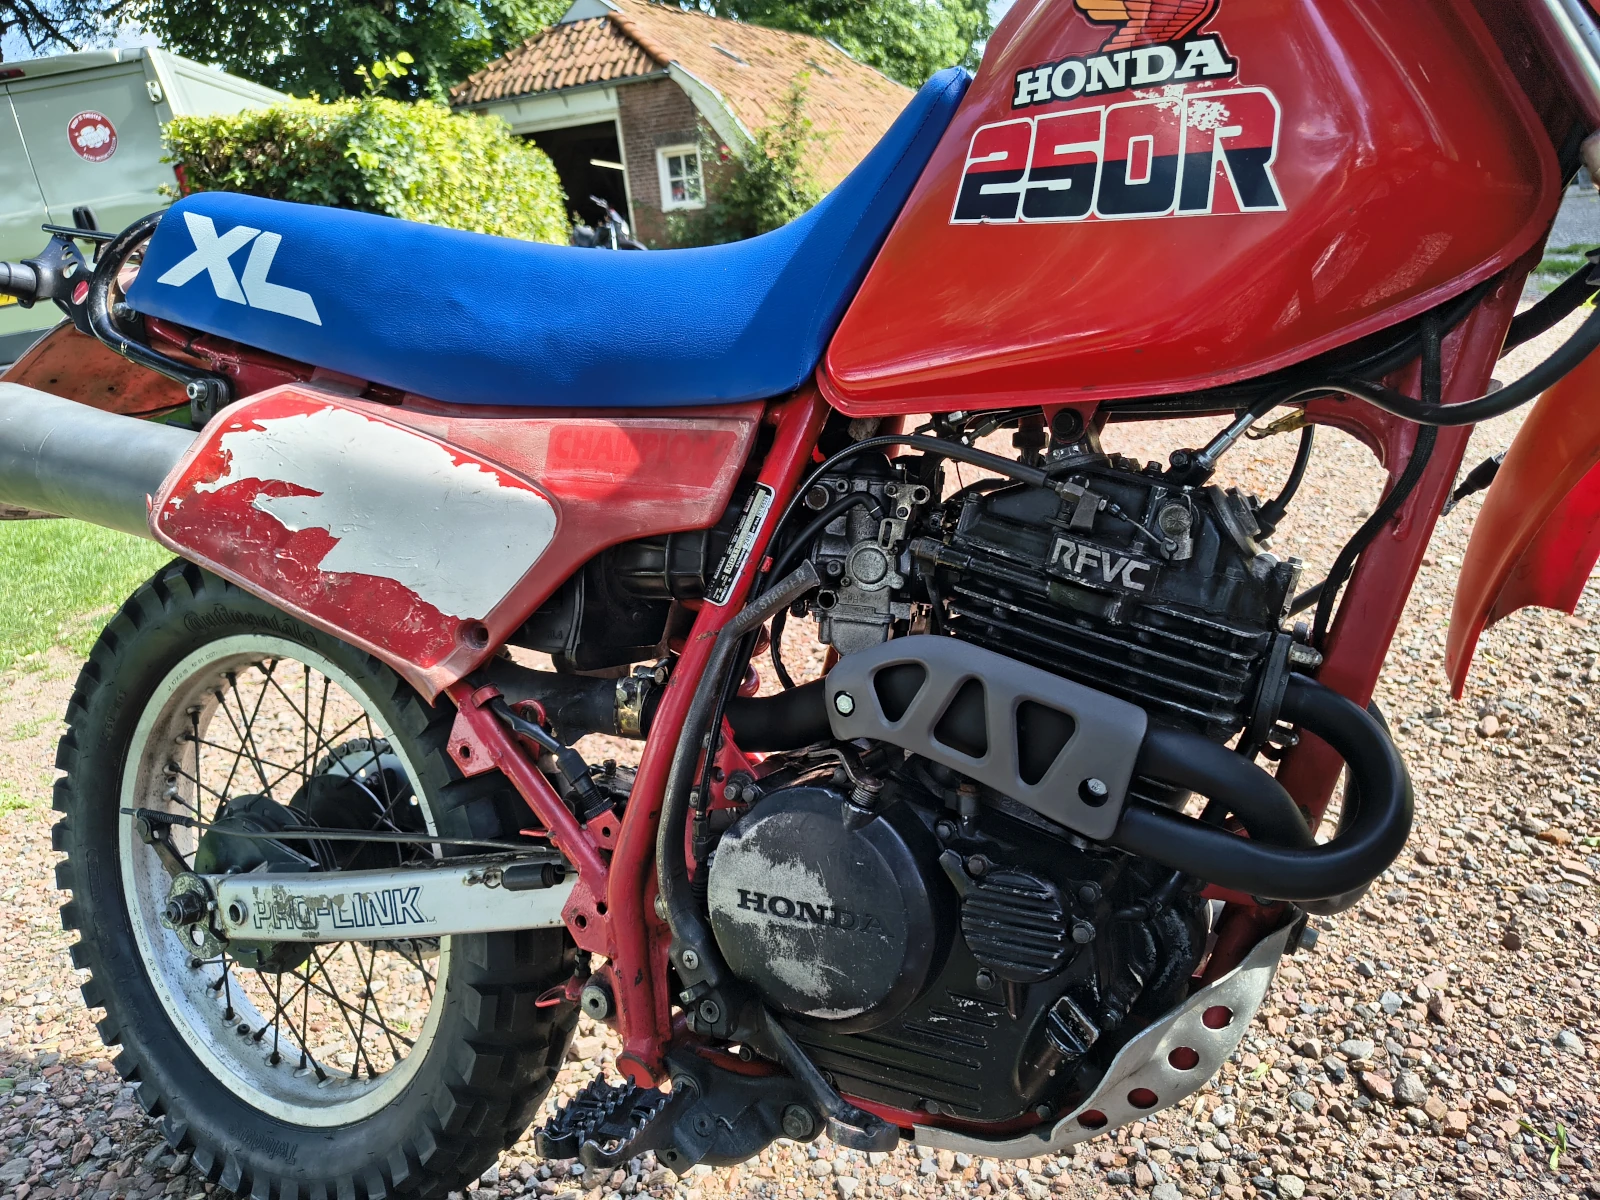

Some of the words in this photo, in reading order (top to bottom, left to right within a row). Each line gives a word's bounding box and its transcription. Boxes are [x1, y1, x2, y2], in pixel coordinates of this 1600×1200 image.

[1013, 39, 1232, 106] HONDA
[949, 86, 1288, 226] 250R
[157, 211, 322, 326] XL
[555, 429, 718, 464] CHAMPION
[1049, 538, 1151, 591] RFVC
[735, 602, 760, 626] KICK
[759, 569, 806, 611] STARTER
[253, 886, 425, 929] PRO-LINK
[737, 888, 894, 938] HONDA
